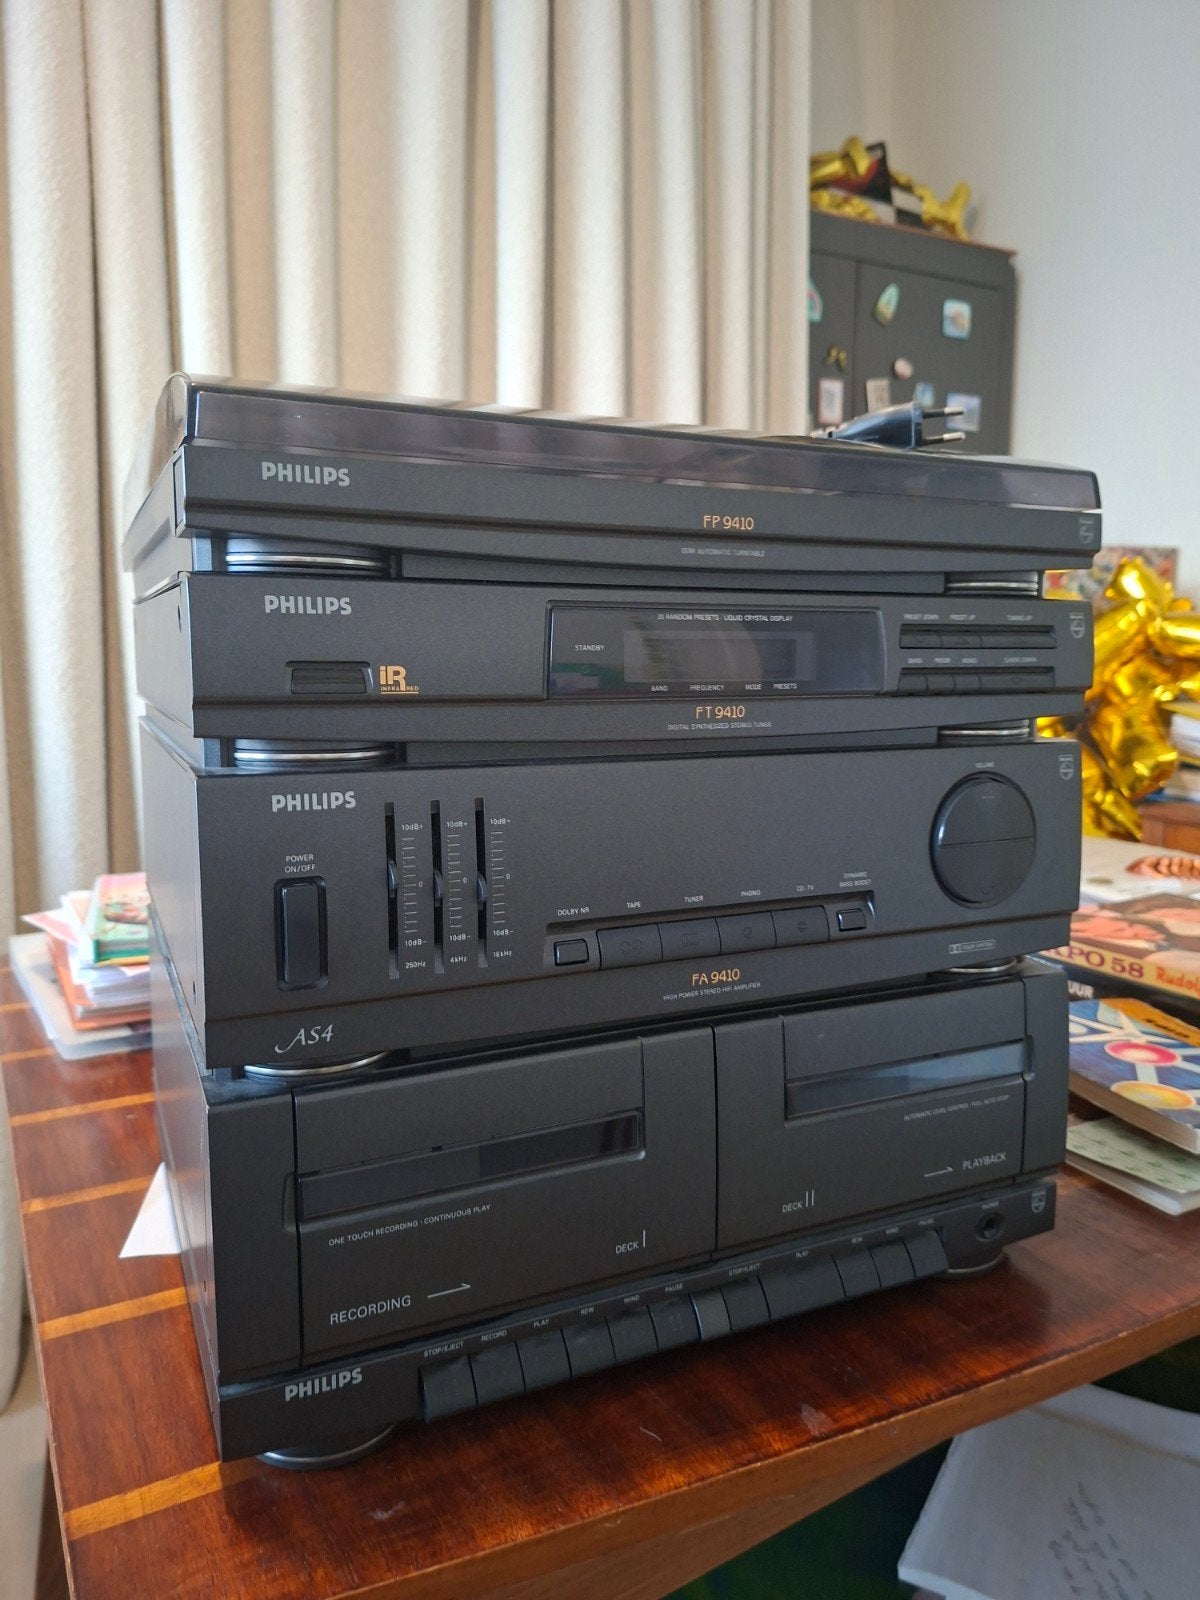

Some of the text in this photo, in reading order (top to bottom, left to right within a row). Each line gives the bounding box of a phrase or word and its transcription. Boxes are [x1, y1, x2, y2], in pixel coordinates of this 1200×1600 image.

[262, 461, 350, 486] PHILIPS
[703, 515, 754, 530] FP 9410
[264, 594, 352, 615] PHILIPS
[665, 613, 692, 621] RANDOM
[744, 614, 769, 622] CRYSTAL
[695, 705, 745, 719] FT 9410
[667, 723, 689, 731] DIGITAL
[271, 791, 356, 812] PHILIPS
[286, 853, 314, 862] POWER
[284, 863, 316, 873] ON/OFF
[684, 895, 704, 903] TUNER
[740, 889, 761, 897] PHONO
[557, 906, 590, 916] DOLBY NR
[405, 960, 426, 969] 250Hz
[449, 955, 467, 963] 4kHz
[692, 968, 740, 986] FA 9410
[1110, 956, 1144, 979] 58
[1154, 966, 1200, 999] Rudol
[663, 992, 678, 1000] HIGH
[678, 990, 699, 999] POWER
[699, 987, 721, 996] STEREO
[733, 981, 761, 991] AMPLIFIER
[275, 1024, 334, 1053] AS4
[962, 1151, 1008, 1170] PLAYBACK
[782, 1200, 803, 1213] DECK
[328, 1203, 491, 1246] ONE TOUCH RECORDING CONTINUOUS PLAY
[615, 1240, 640, 1254] DECK
[664, 1283, 684, 1293] PAUSE
[330, 1294, 411, 1326] RECORDING
[580, 1306, 595, 1316] REW
[533, 1318, 550, 1328] PLAY
[480, 1329, 508, 1342] RECORD
[423, 1341, 465, 1358] STOP/EJECT
[284, 1367, 363, 1402] PHILIPS
